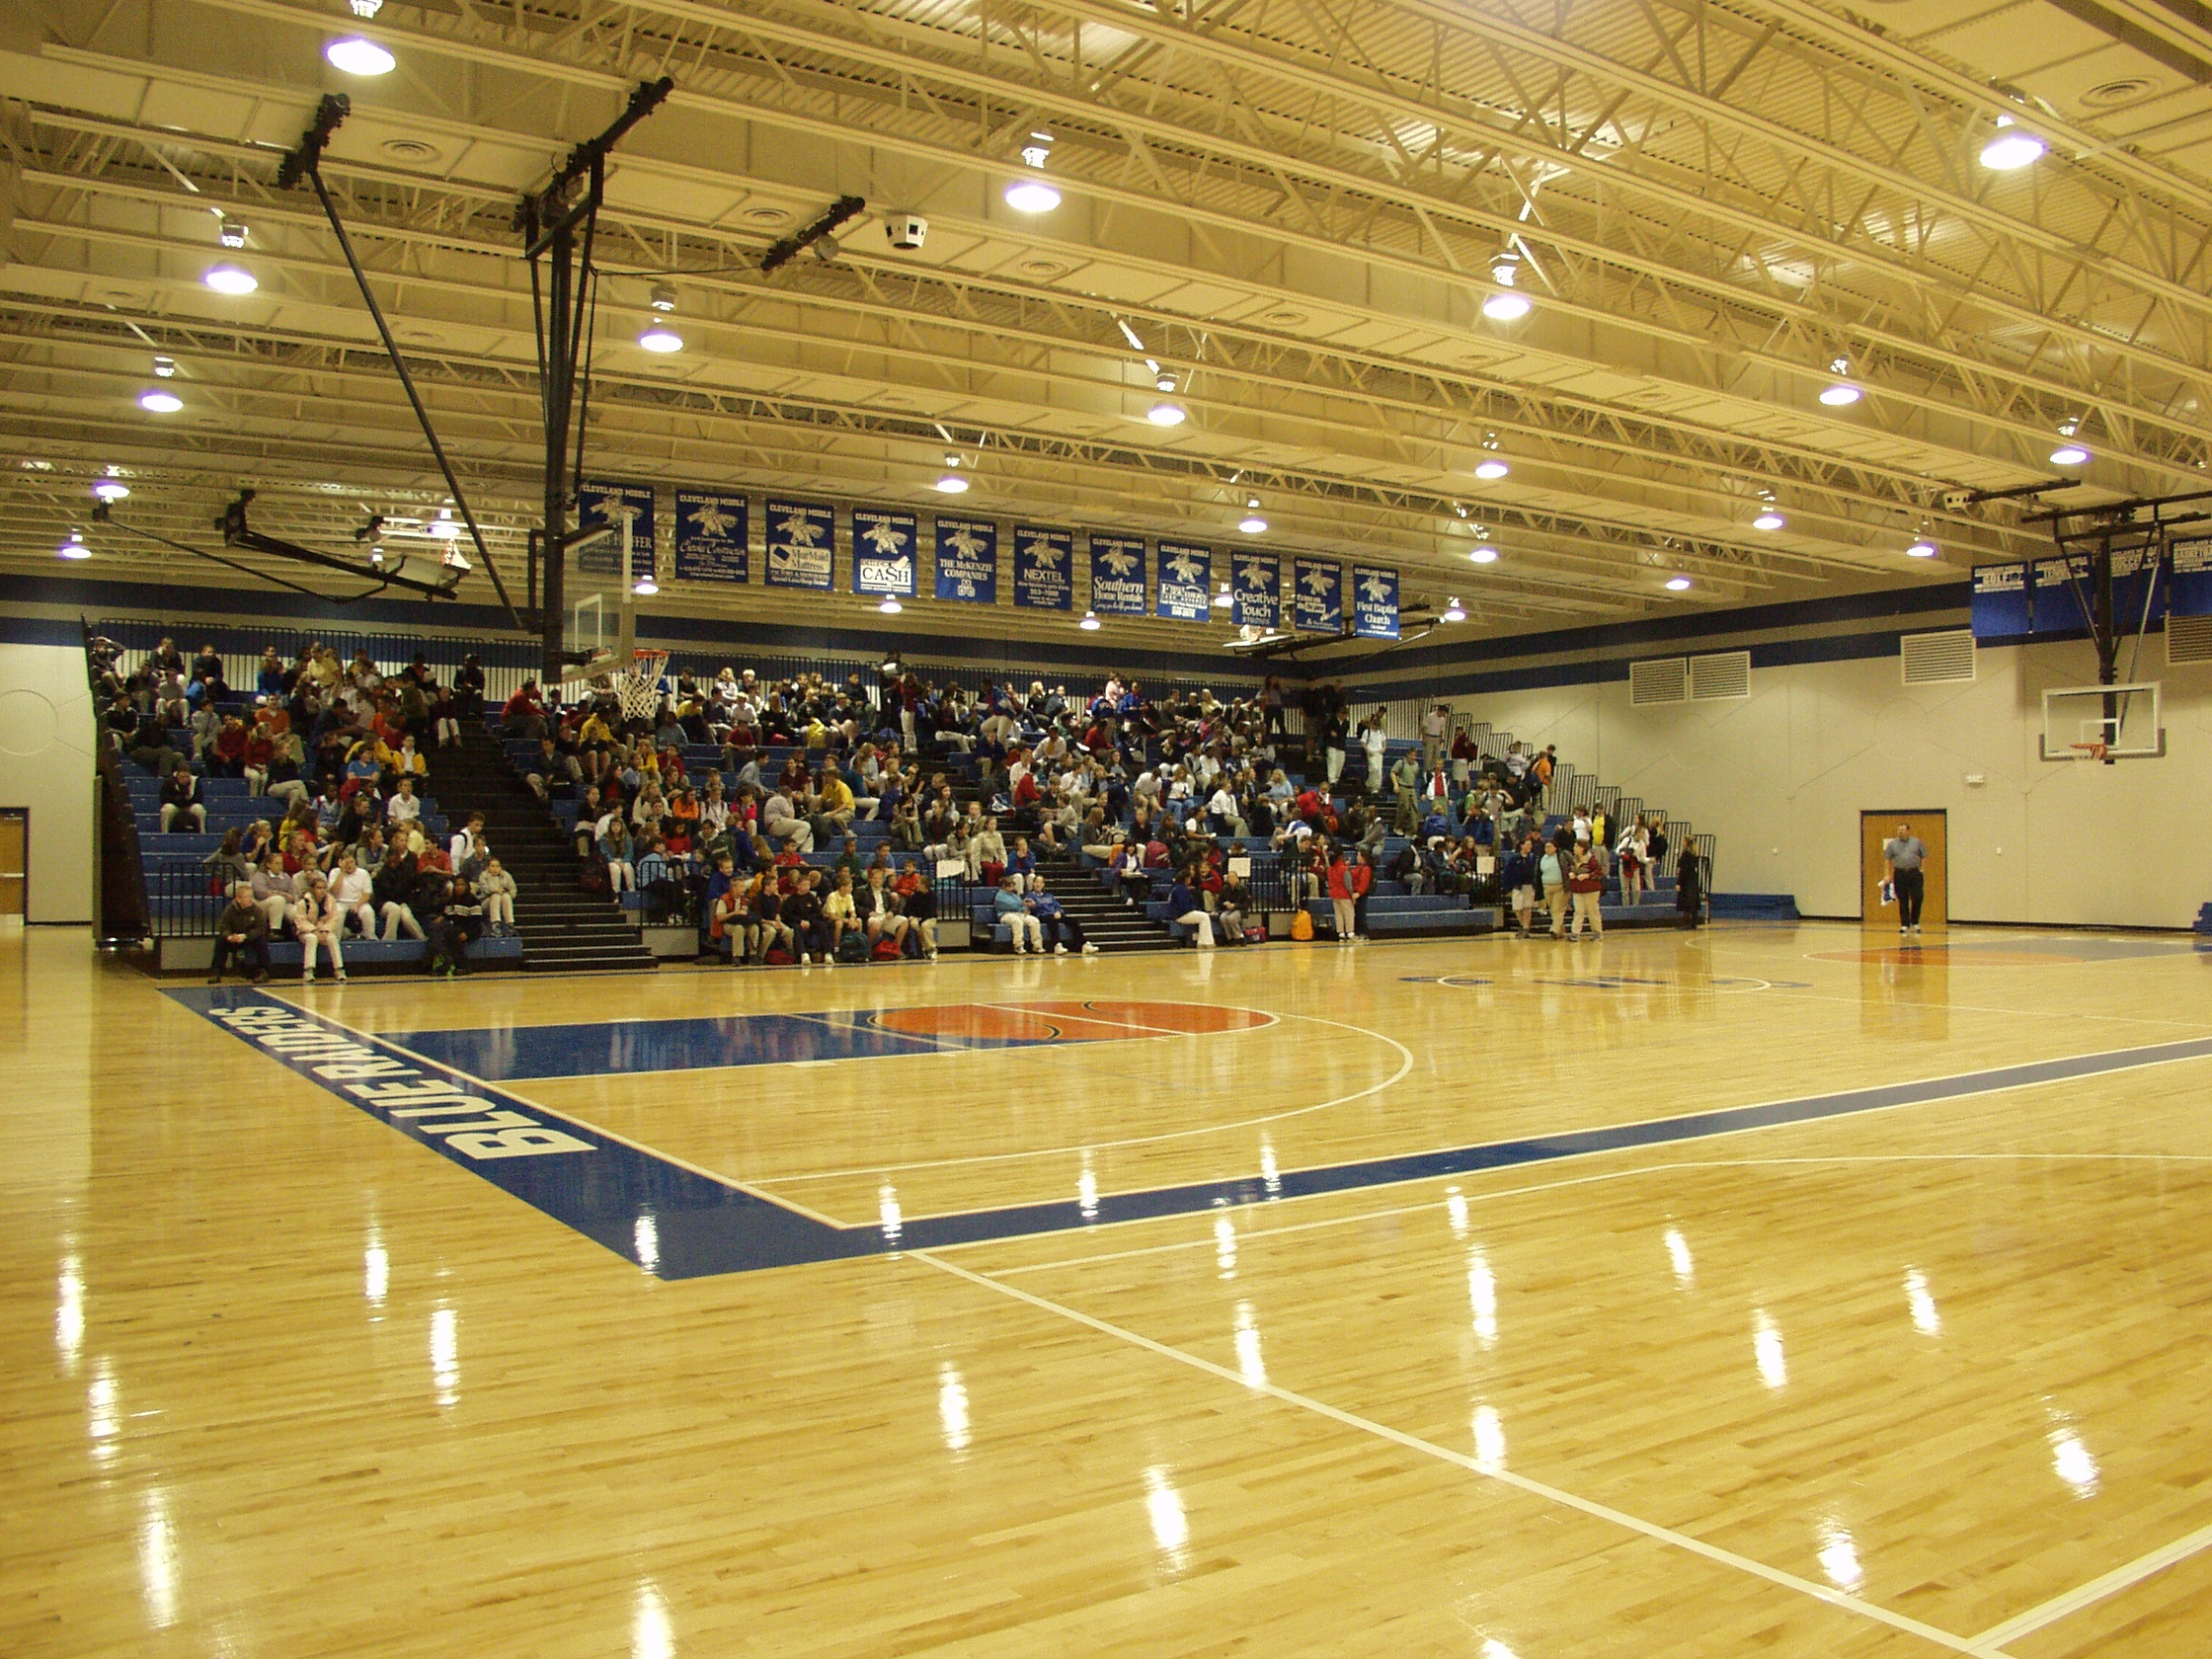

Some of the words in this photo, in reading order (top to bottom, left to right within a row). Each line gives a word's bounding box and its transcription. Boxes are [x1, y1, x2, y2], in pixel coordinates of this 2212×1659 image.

[583, 485, 623, 496] CLEVELAND
[679, 495, 719, 505] CLEVELAND
[769, 504, 807, 514] CLEVELAND
[855, 513, 891, 523] CLEVELAND
[937, 520, 971, 529] CLEVELAND
[1017, 530, 1049, 539] CLEVELAND
[1092, 538, 1123, 547] CLEVELAND
[1160, 545, 1189, 554] CLEVELAND
[939, 558, 956, 569] THE
[862, 564, 908, 583] CASH
[1024, 568, 1065, 583] NEXTEL
[1094, 576, 1144, 593] Southern
[1233, 589, 1279, 605] Creative
[1240, 602, 1271, 617] Touch
[1374, 603, 1397, 615] Baptist
[1365, 613, 1390, 625] Church
[208, 1005, 423, 1079] RAIDERS
[343, 1079, 597, 1160] BLUE
